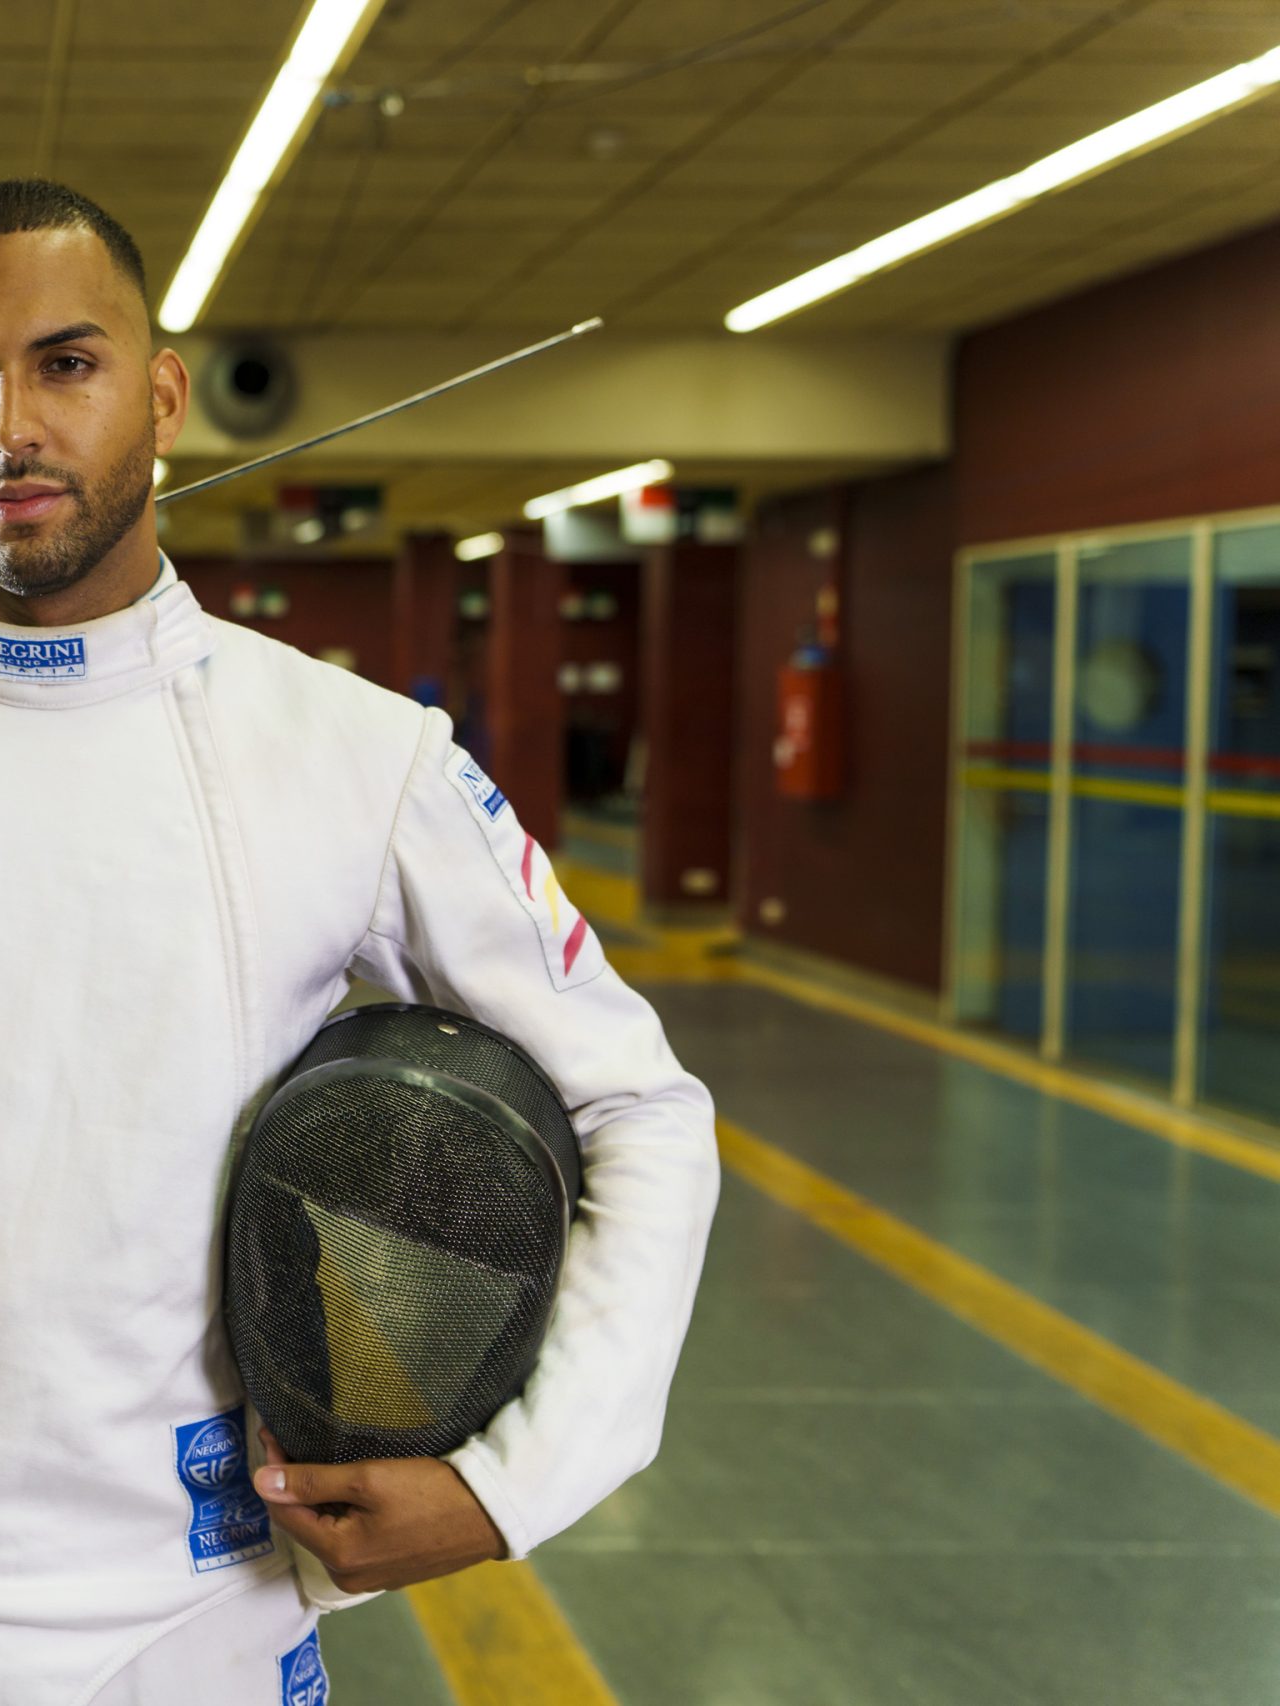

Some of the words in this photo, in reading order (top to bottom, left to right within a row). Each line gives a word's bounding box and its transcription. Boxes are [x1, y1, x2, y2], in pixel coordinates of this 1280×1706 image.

[49, 657, 83, 666] LINE
[198, 1523, 260, 1549] NEGRINI
[205, 1544, 267, 1567] ITALIA
